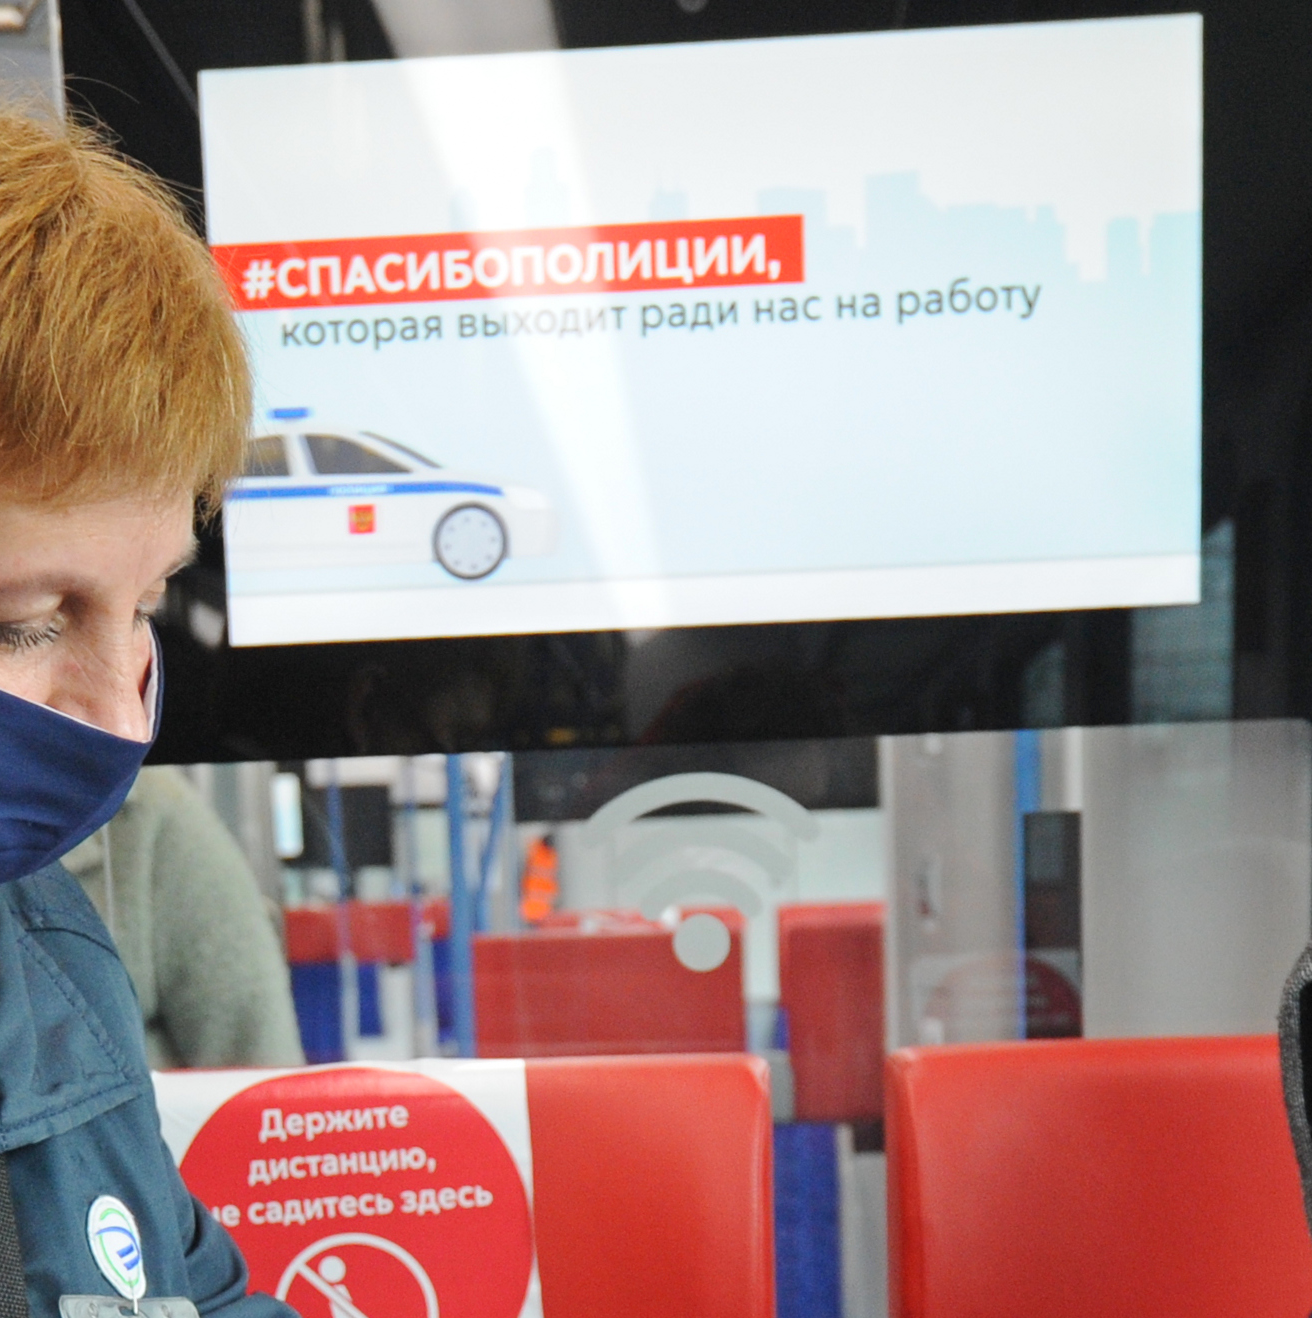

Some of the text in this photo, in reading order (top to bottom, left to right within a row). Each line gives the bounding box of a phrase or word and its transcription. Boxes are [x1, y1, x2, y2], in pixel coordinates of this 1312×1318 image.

[242, 233, 782, 300] #СПАСИБОПОЛИЦИИ,
[281, 277, 1043, 350] которая выходит ради нас на работу
[258, 1105, 409, 1143] Держите
[248, 1147, 436, 1187] дистанцию,
[247, 1193, 394, 1226] садитесь
[400, 1185, 493, 1216] здесь
